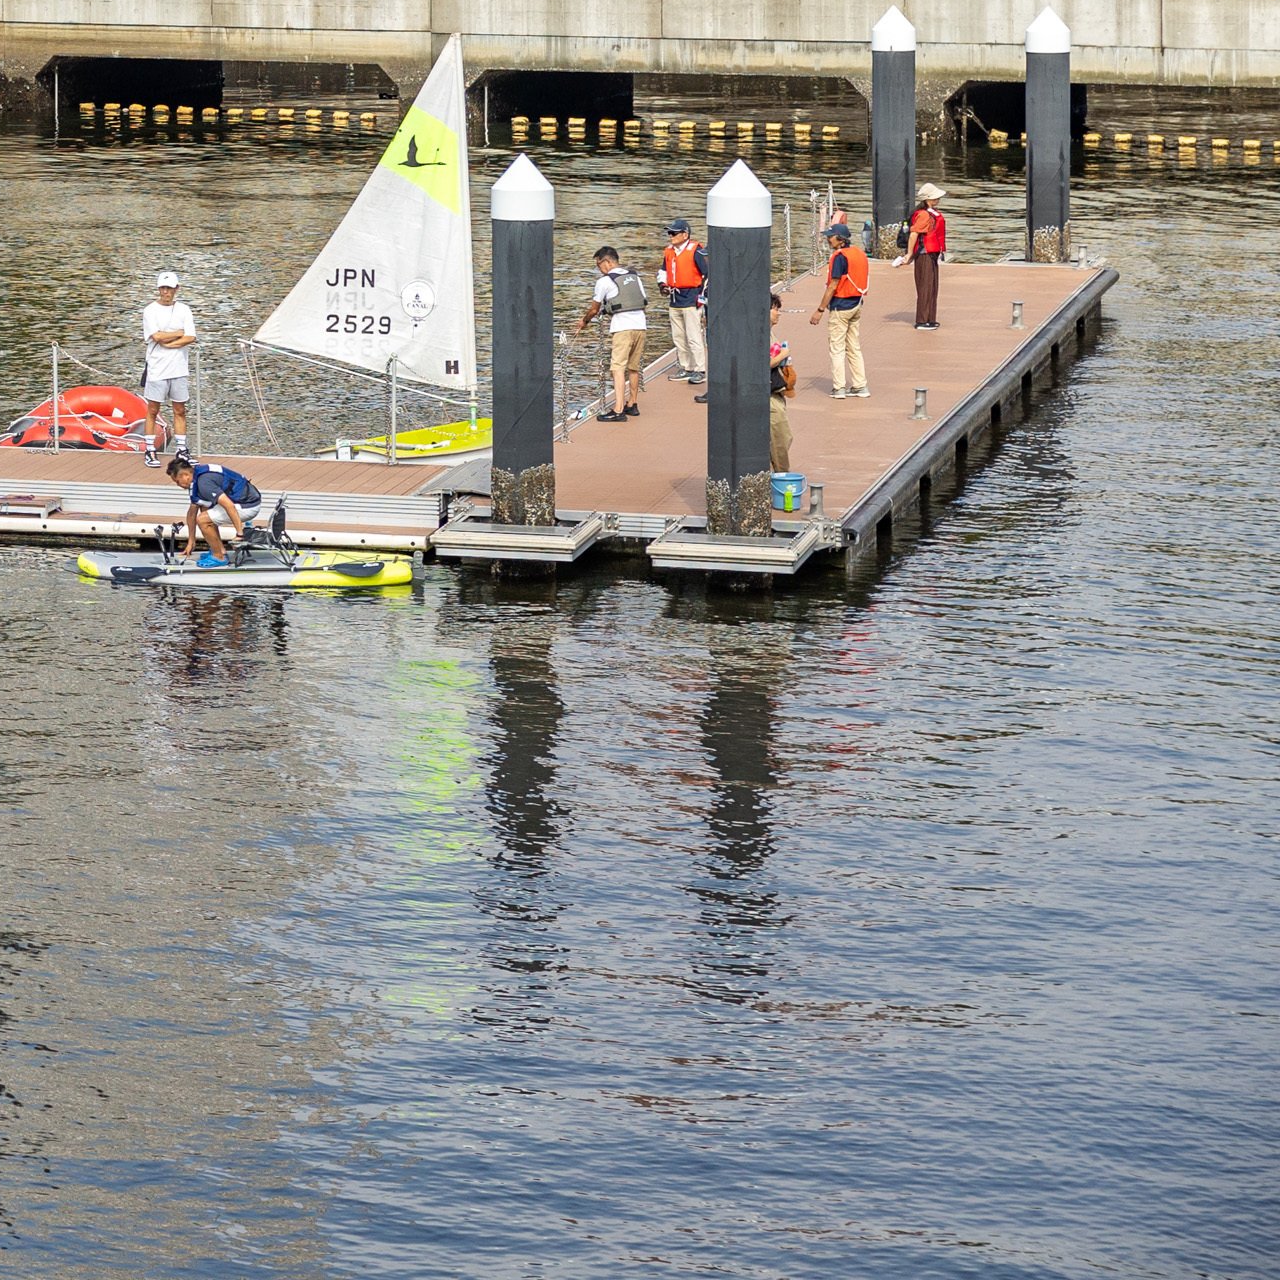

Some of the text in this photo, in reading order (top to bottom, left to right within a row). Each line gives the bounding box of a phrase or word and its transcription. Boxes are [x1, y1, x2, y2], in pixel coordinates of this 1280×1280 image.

[325, 268, 376, 288] JPN
[325, 314, 391, 335] 2529
[445, 360, 460, 375] H
